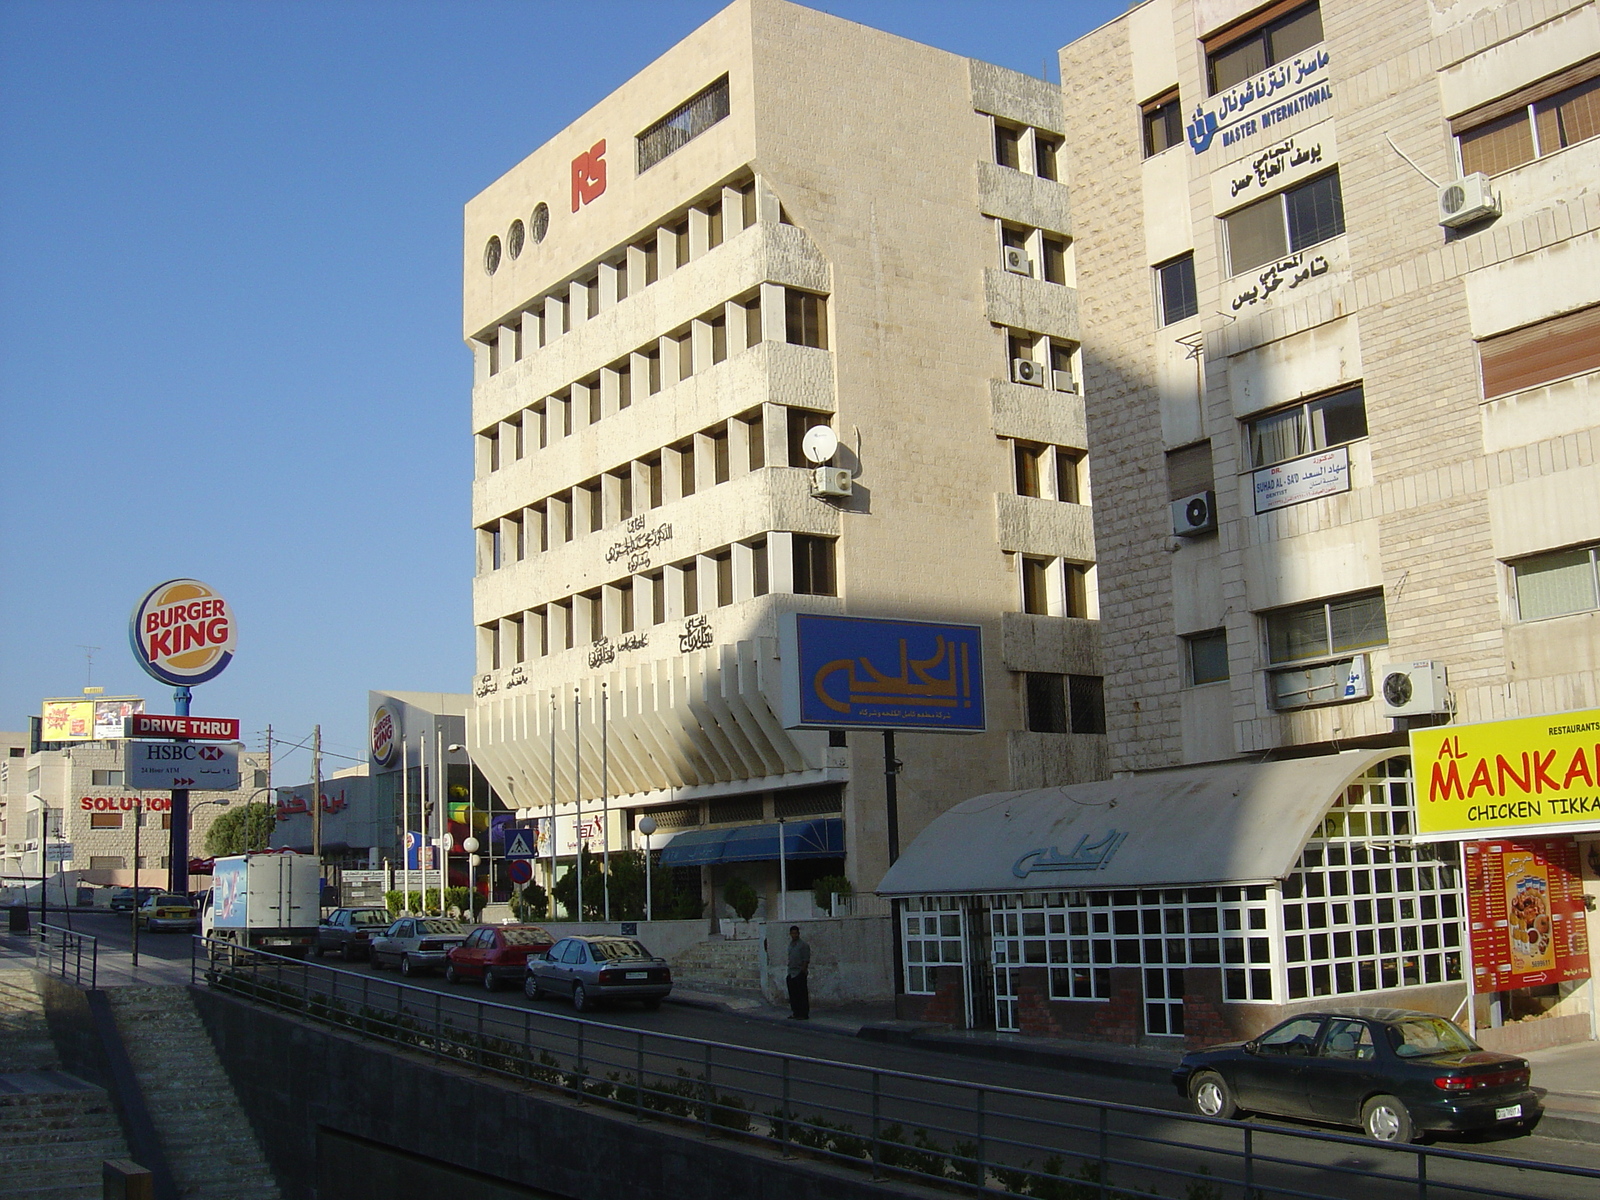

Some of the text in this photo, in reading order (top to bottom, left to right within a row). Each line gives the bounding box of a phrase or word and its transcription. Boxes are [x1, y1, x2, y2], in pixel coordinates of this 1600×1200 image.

[1219, 50, 1330, 120] ماستر انترناشونال
[1222, 84, 1333, 147] MASTER INTERNATIONAL
[1253, 138, 1294, 169] المحامي
[571, 138, 606, 213] RS
[1231, 143, 1322, 198] يوسف الحاج حسن
[1259, 252, 1303, 285] المحامي
[1289, 256, 1329, 289] تامر
[1256, 482, 1275, 494] SUHAD
[1302, 466, 1327, 481] السعد
[1266, 488, 1288, 499] DENTIST
[146, 599, 225, 634] BURGER
[149, 617, 228, 662] KING
[140, 718, 232, 735] DRIVE THRU
[373, 714, 392, 738] BURGER
[373, 724, 393, 754] KING
[147, 744, 197, 761] HSBC
[1438, 735, 1468, 760] AL
[1467, 801, 1542, 821] CHICKEN
[1547, 796, 1600, 815] TIKKA
